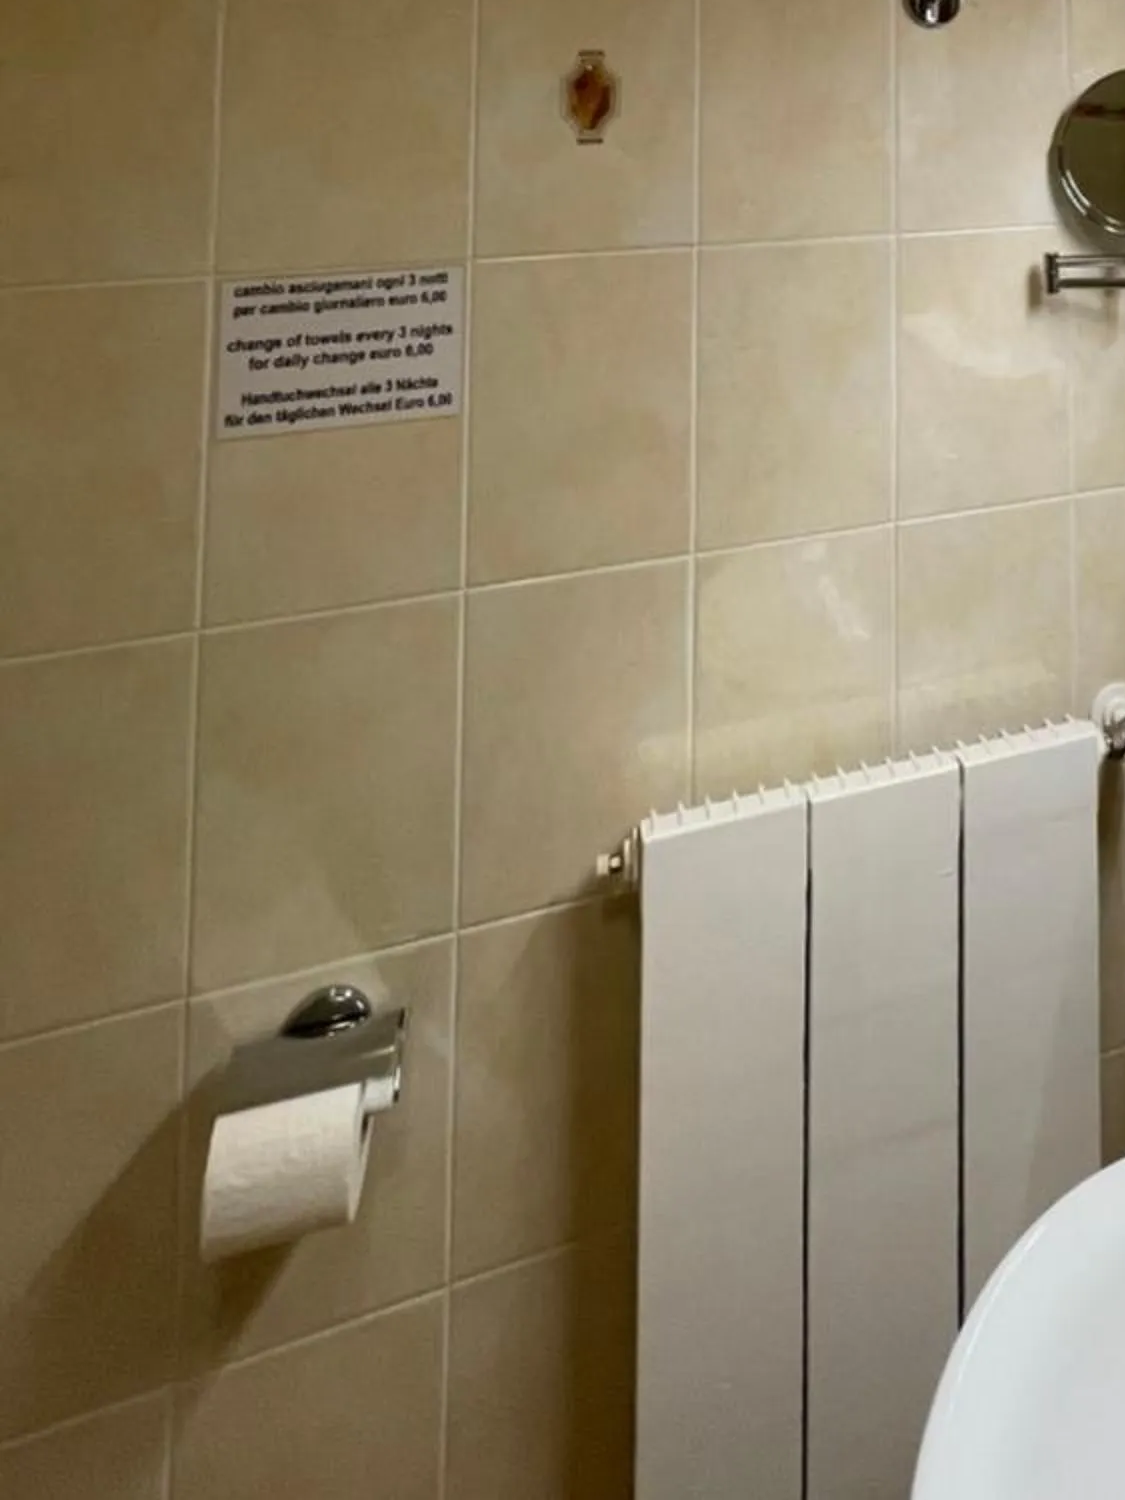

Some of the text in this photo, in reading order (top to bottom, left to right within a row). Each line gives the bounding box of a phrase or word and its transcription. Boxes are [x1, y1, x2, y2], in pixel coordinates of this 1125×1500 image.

[233, 283, 284, 298] cambio
[376, 274, 405, 291] ogni
[408, 273, 417, 287] 3
[232, 306, 256, 319] per
[259, 300, 311, 315] cambio
[388, 294, 418, 306] euro
[226, 323, 453, 353] change of towels every 3 nights
[248, 356, 270, 372] for
[272, 354, 309, 371] daily
[312, 350, 366, 367] change
[369, 348, 402, 359] euro
[360, 382, 382, 395] alle
[385, 379, 393, 393] 3
[246, 411, 273, 425] den
[337, 397, 393, 416] Wechsel
[395, 396, 425, 411] Euro
